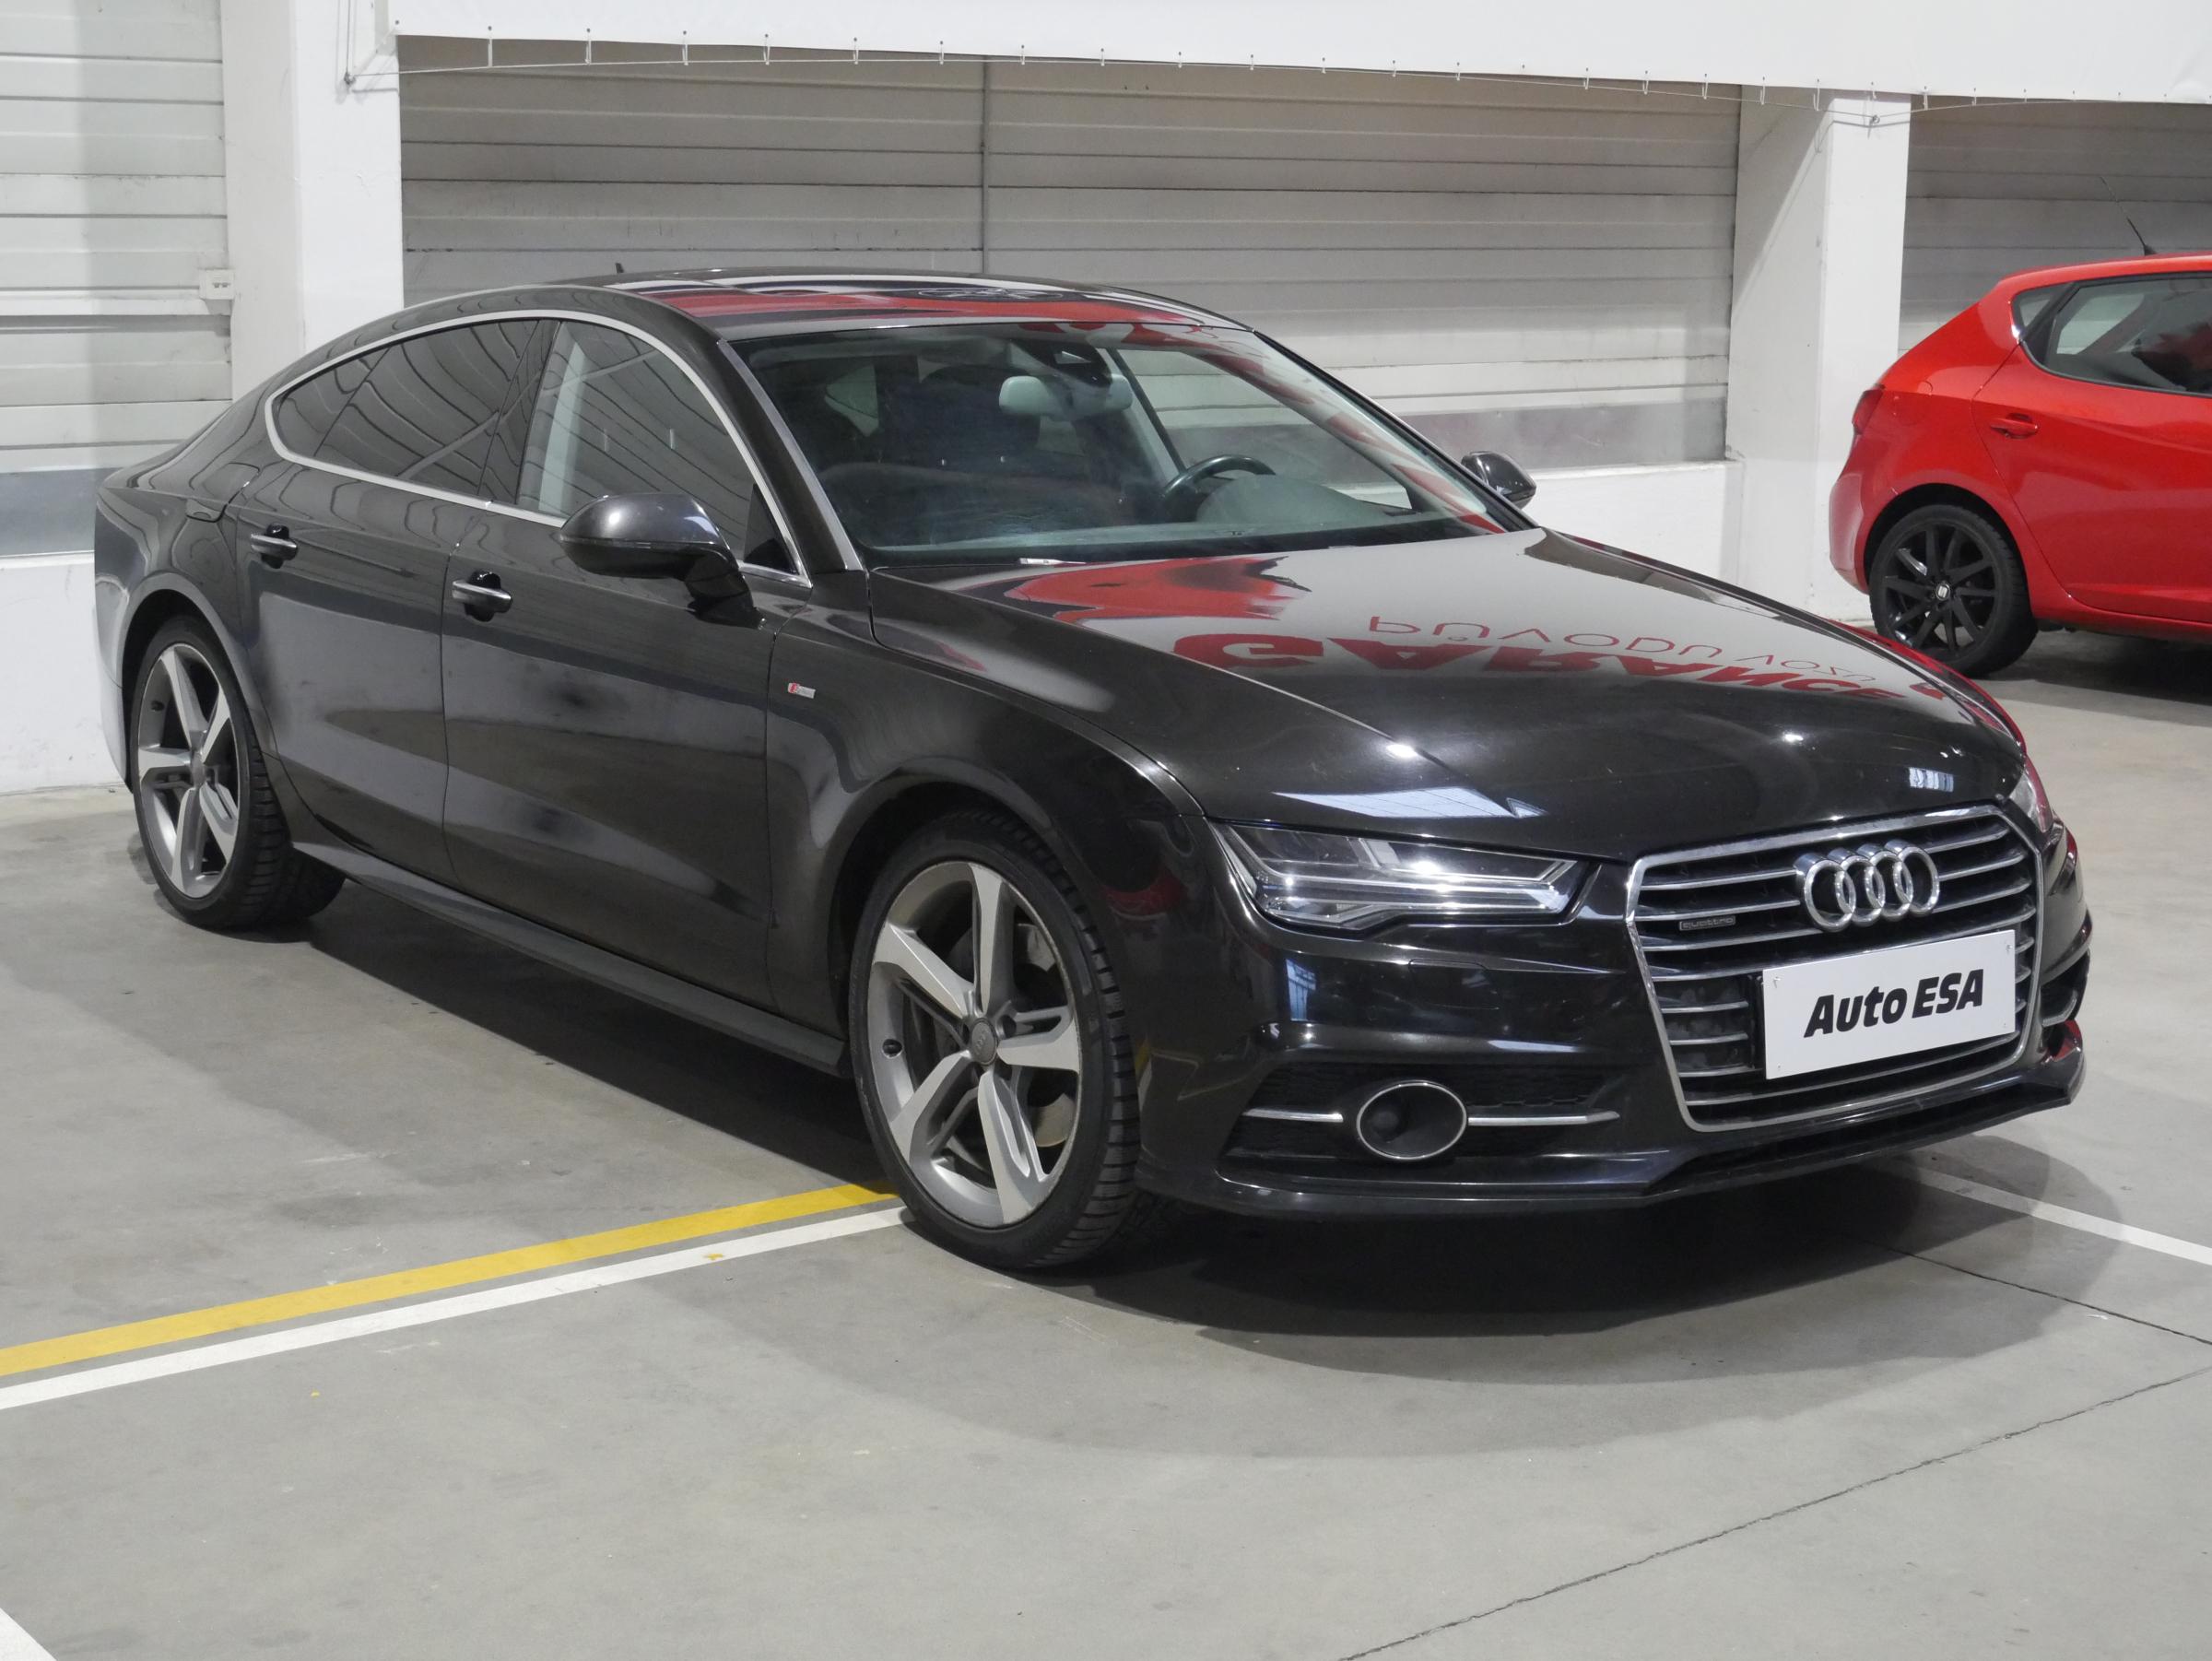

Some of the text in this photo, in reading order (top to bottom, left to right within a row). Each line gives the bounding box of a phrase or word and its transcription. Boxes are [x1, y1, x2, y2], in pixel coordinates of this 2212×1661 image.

[1682, 917, 1735, 930] quattro
[1803, 969, 1984, 1038] Auto ESA
